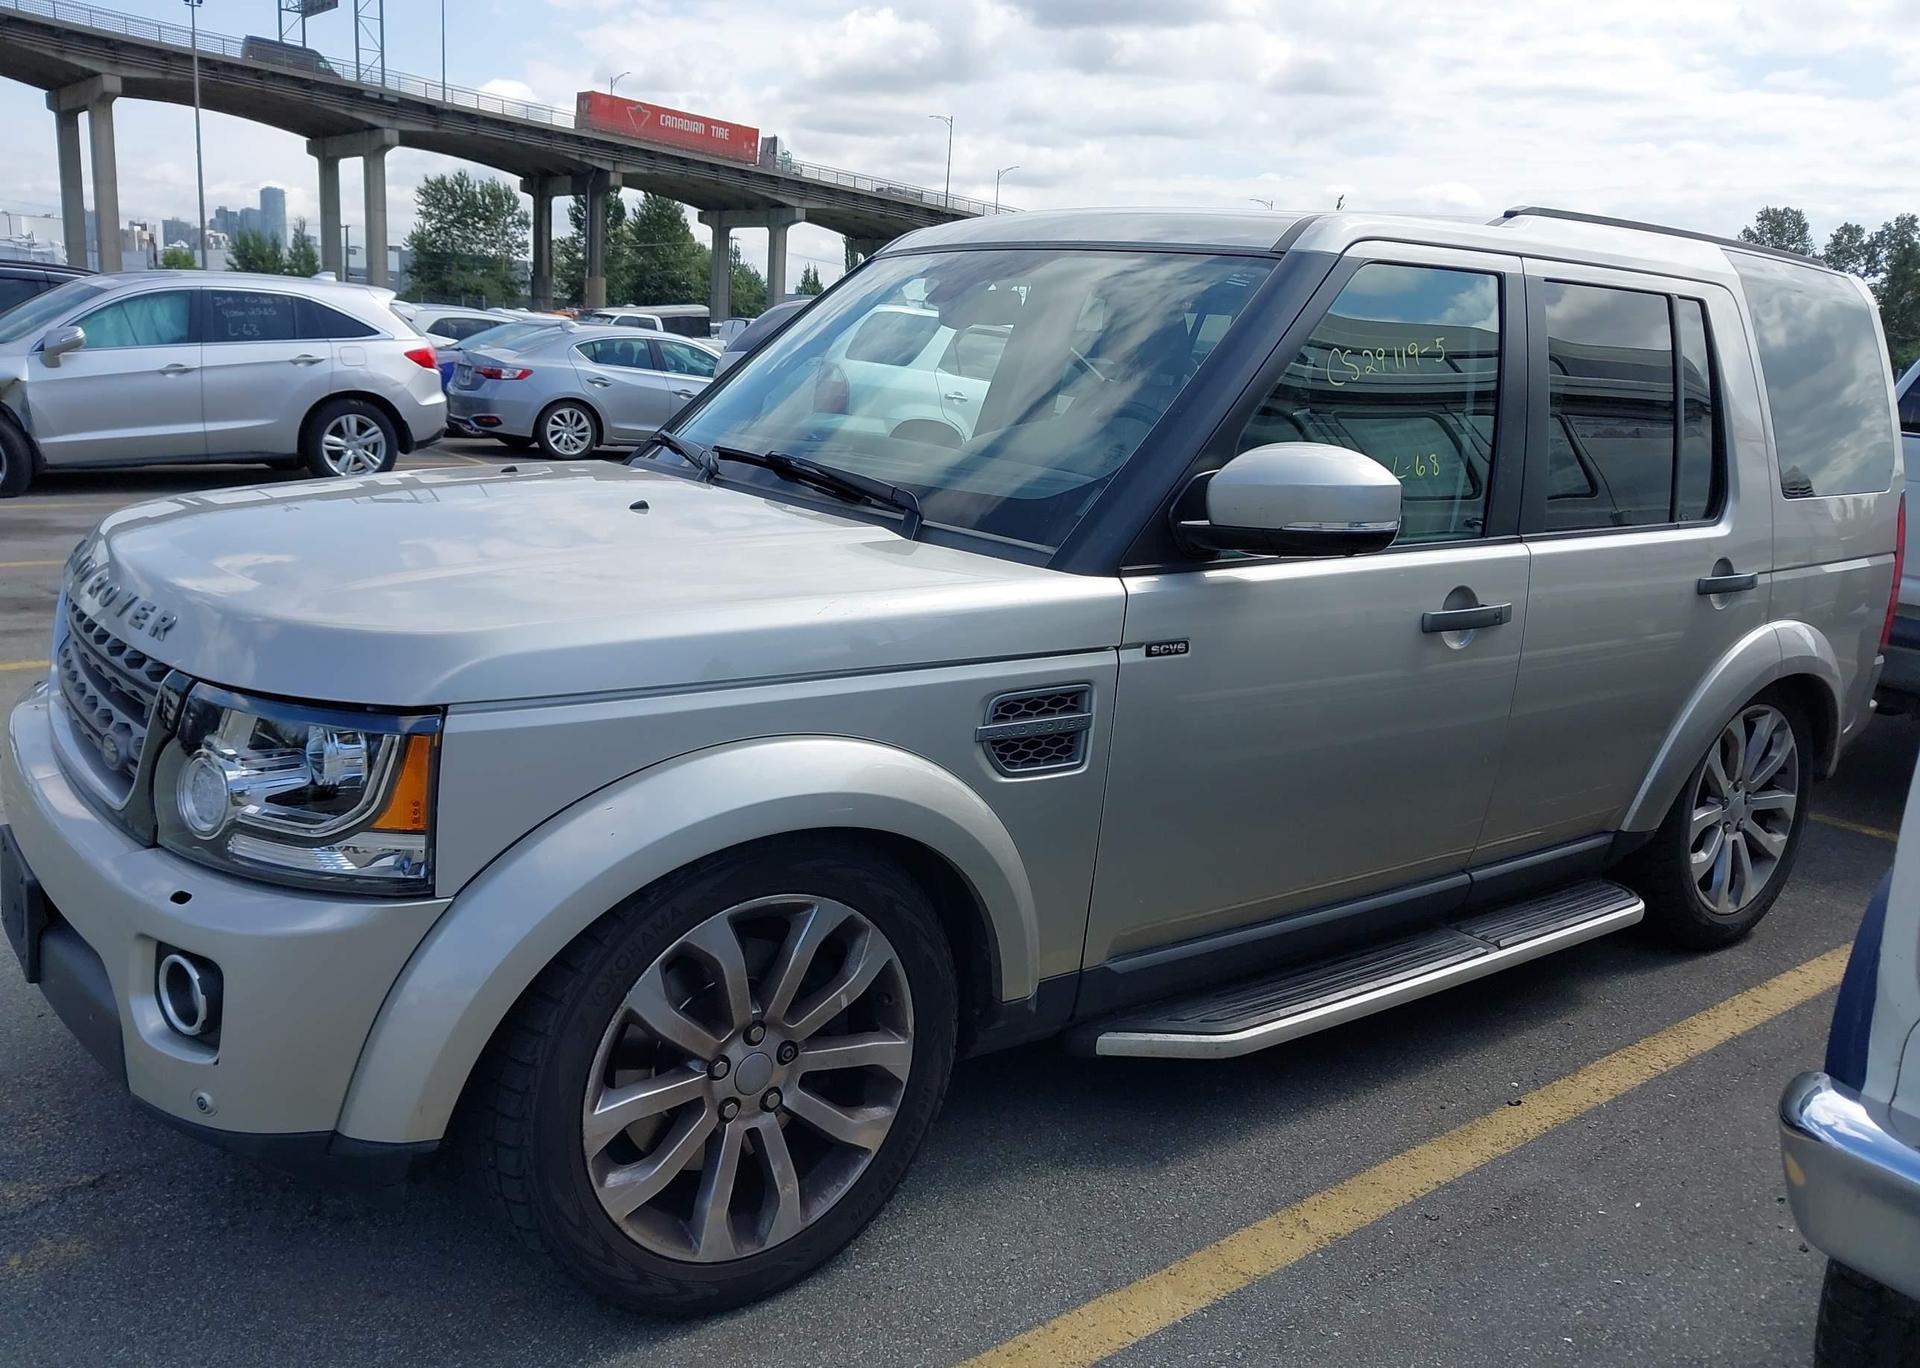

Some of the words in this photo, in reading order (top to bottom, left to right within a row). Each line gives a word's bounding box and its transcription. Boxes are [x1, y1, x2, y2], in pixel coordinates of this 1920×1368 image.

[659, 114, 705, 135] CANADIAN
[711, 126, 730, 140] TIRE
[1151, 642, 1186, 654] SCV6
[1034, 718, 1087, 734] ROVER
